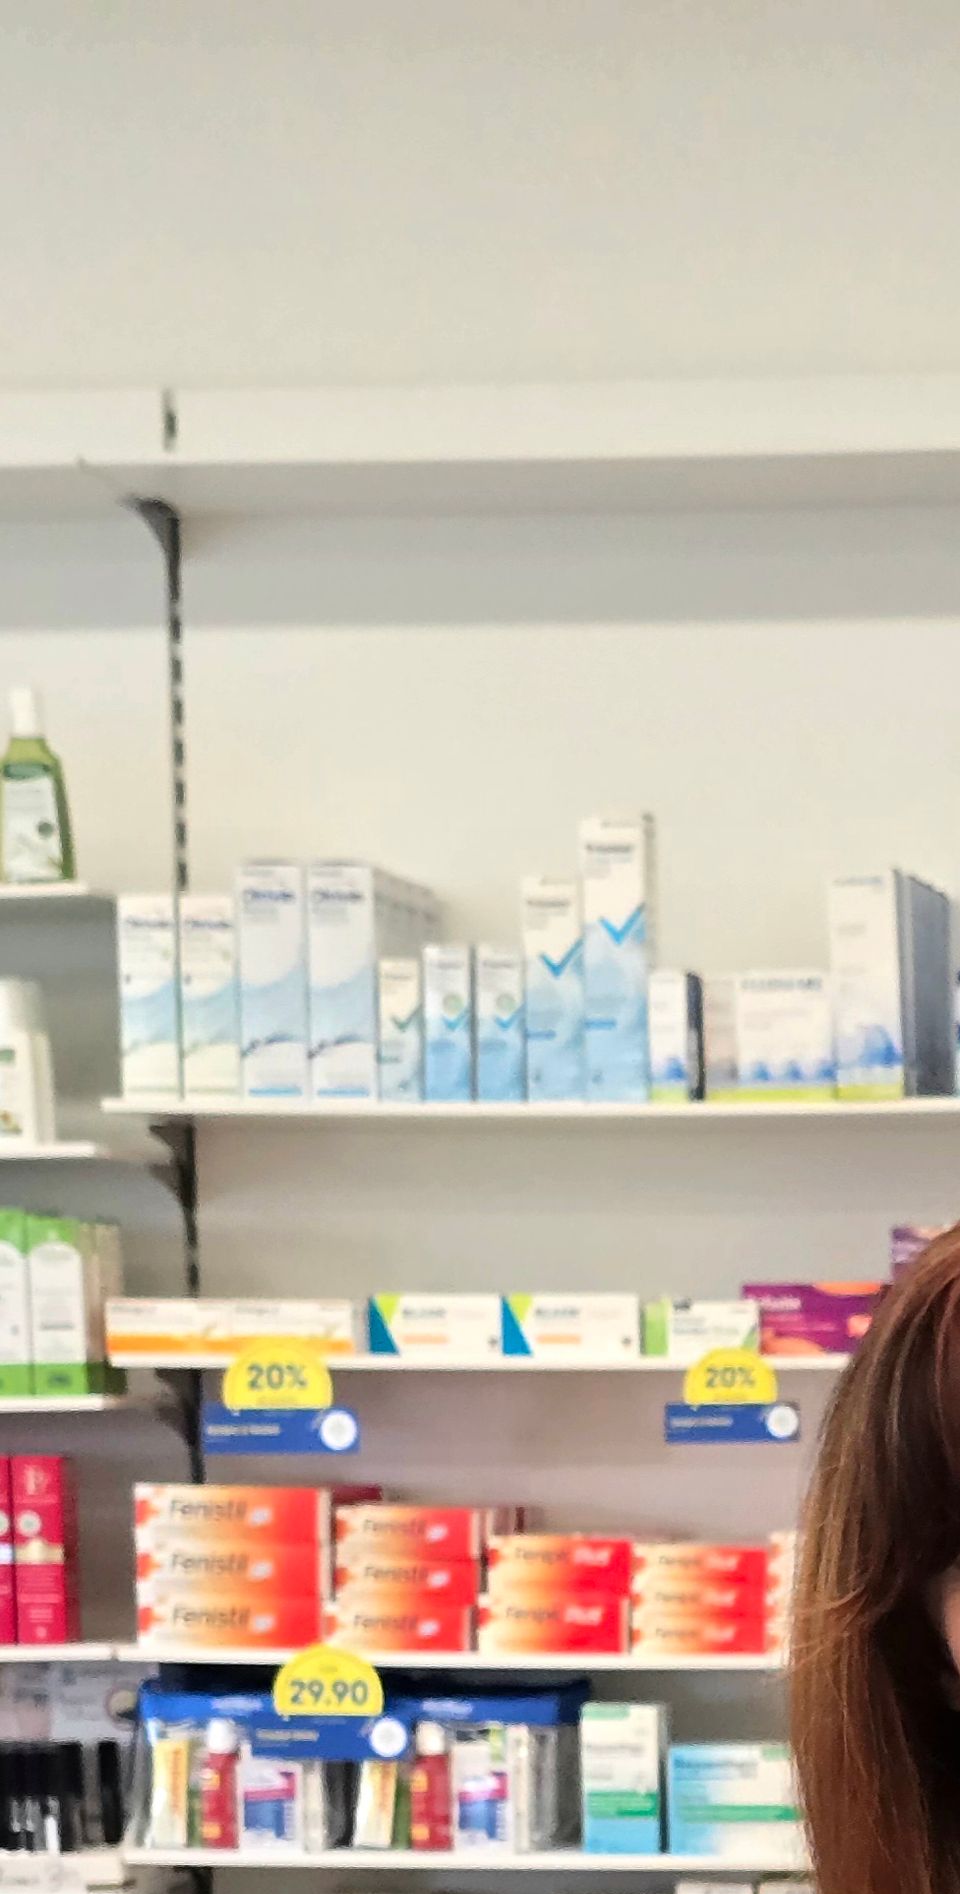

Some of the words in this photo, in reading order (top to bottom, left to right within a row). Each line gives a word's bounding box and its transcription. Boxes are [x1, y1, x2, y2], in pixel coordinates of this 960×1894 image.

[247, 1363, 309, 1391] 20%
[704, 1366, 756, 1389] 20%
[289, 1679, 369, 1706] 29.90
